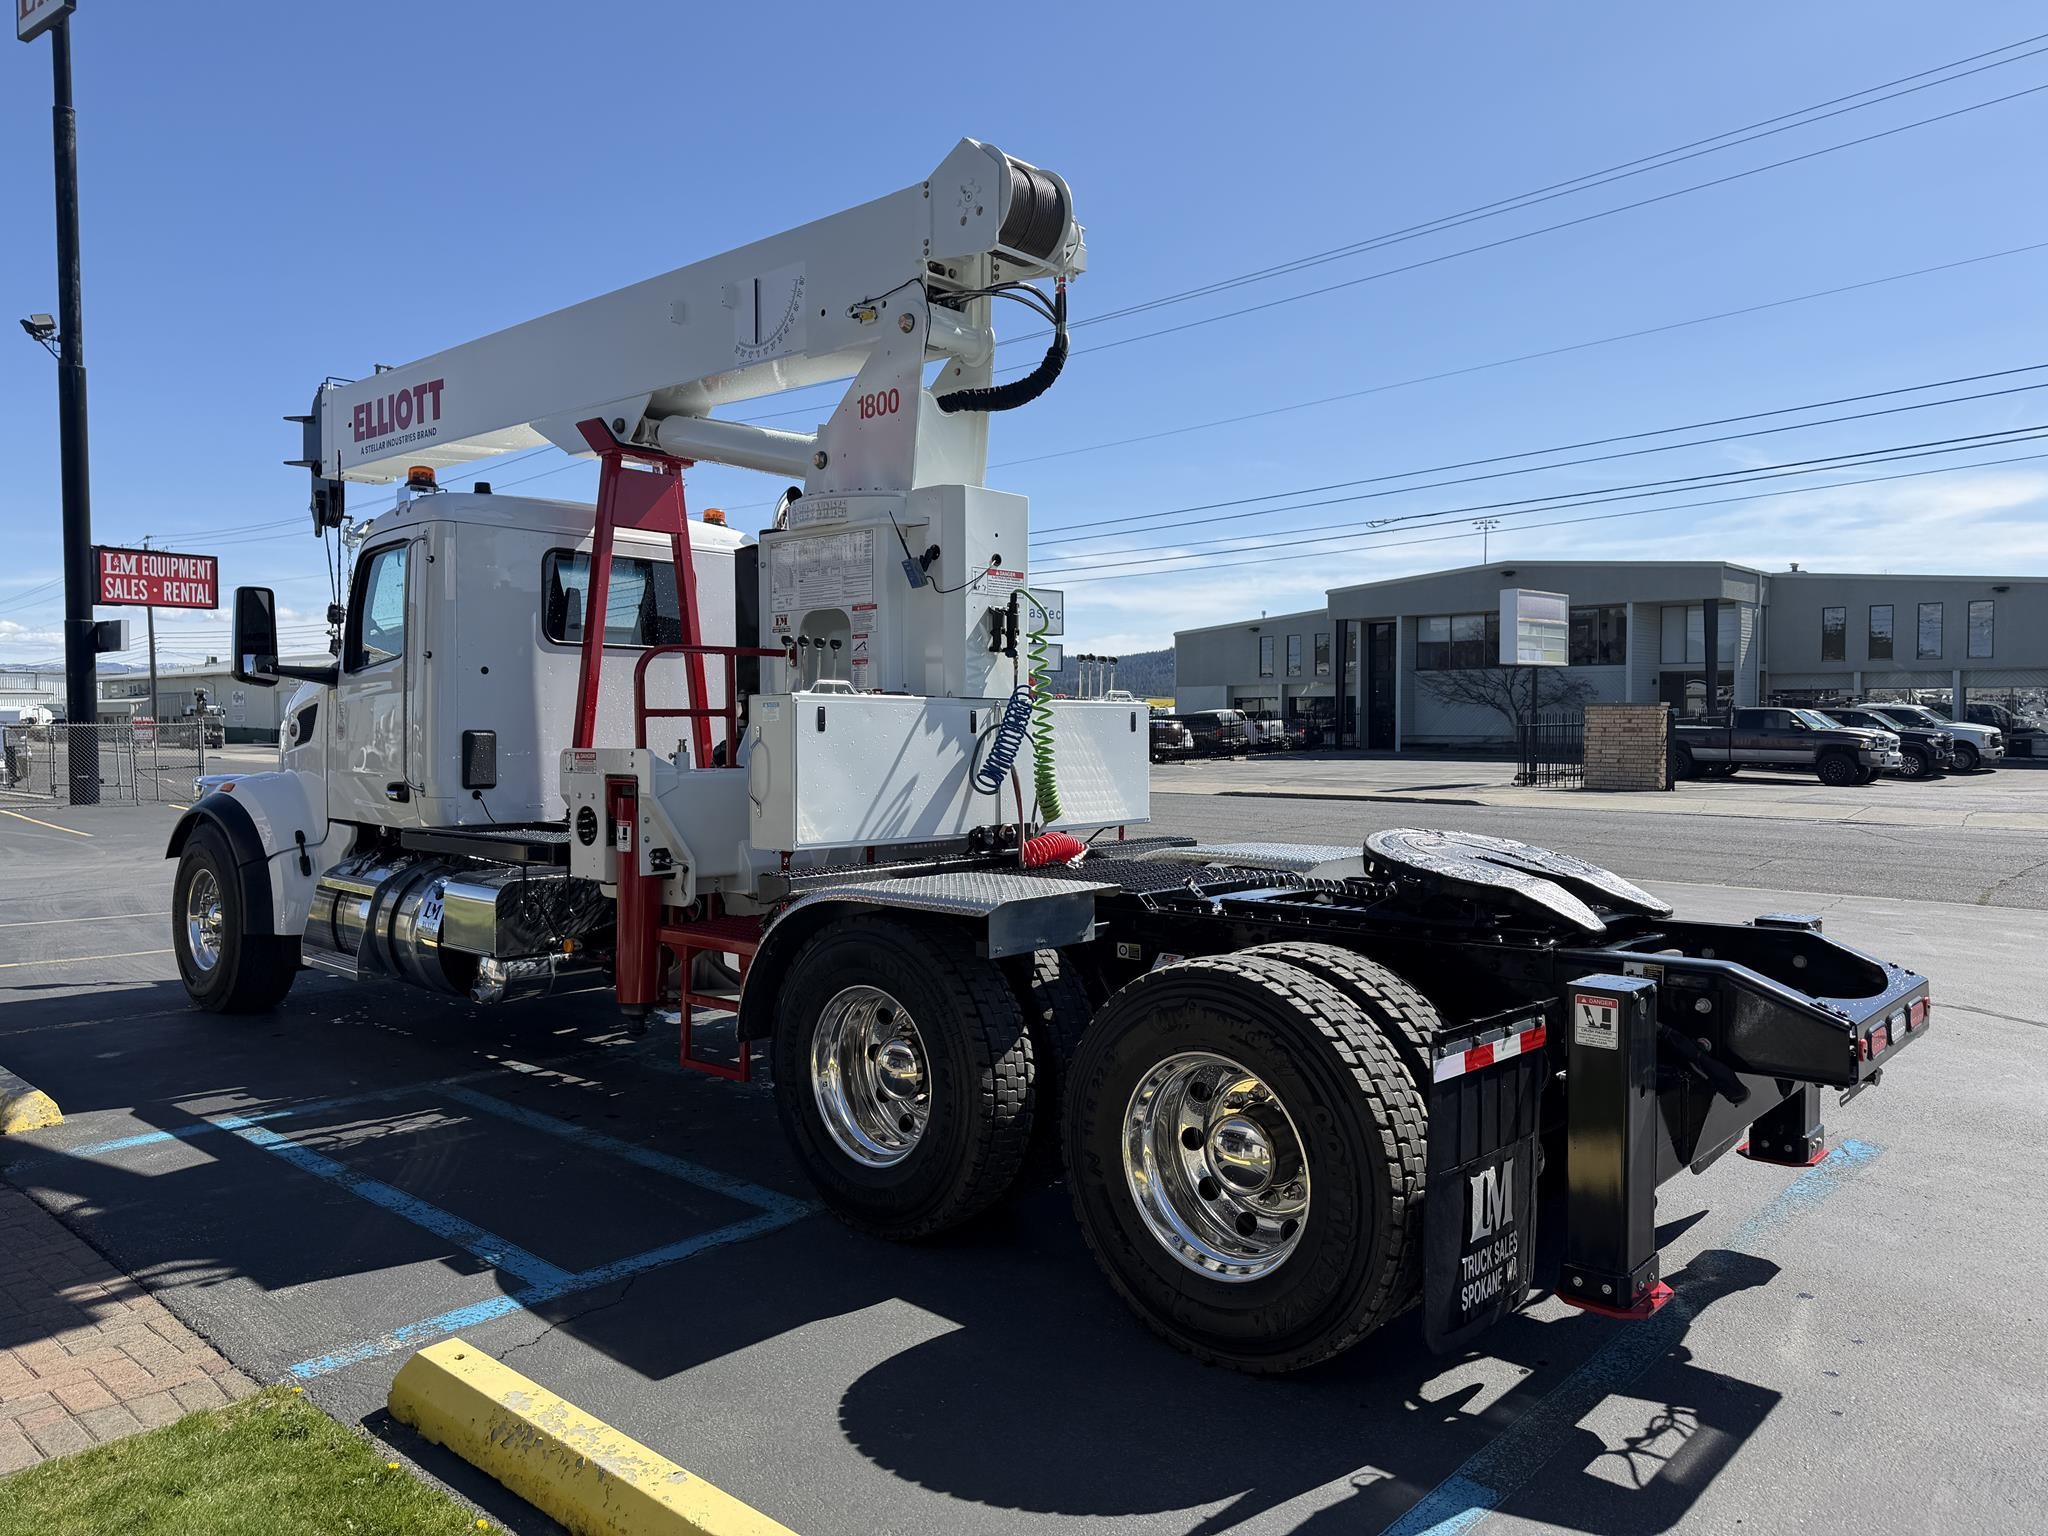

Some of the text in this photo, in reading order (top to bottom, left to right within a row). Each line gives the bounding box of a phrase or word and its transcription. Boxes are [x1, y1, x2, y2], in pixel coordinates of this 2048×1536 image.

[353, 378, 444, 443] ELLIOTT
[857, 388, 899, 419] 1800
[360, 427, 437, 455] A STELLAR INDUSTRIES BRAND
[104, 553, 212, 580] L&M EQUIPMENT
[105, 577, 213, 604] SALES RENTAL
[1588, 998, 1613, 1007] DANGER
[1462, 1230, 1518, 1281] TRUCK SALES
[1461, 1257, 1518, 1312] SPOKANE WA
